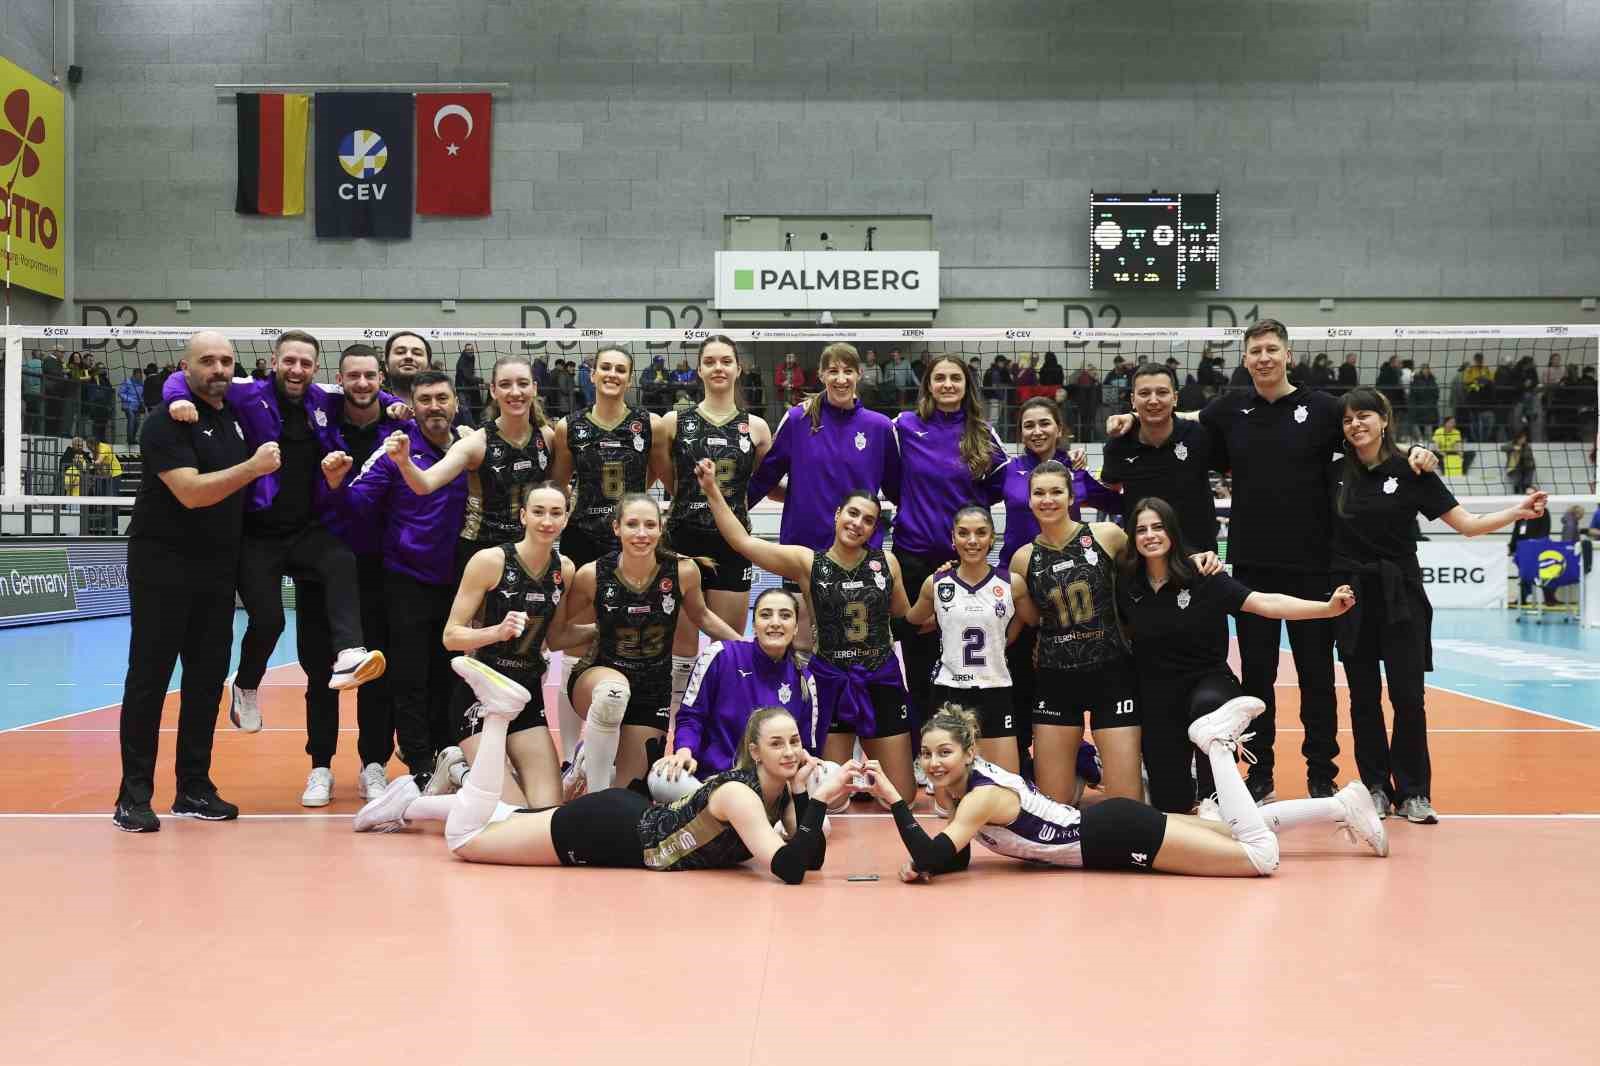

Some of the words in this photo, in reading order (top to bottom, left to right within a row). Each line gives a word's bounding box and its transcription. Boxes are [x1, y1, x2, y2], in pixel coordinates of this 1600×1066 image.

[338, 183, 388, 201] CEV
[760, 270, 920, 290] PALMBERG
[54, 328, 69, 336] CEV
[81, 305, 138, 350] D3
[521, 305, 577, 350] D3
[646, 305, 704, 350] D2
[1016, 330, 1031, 338] CEV
[1064, 304, 1122, 349] D2
[602, 461, 625, 499] 8
[10, 568, 68, 598] Germany
[1421, 567, 1485, 584] BERG
[1050, 580, 1094, 627] 10
[844, 601, 869, 642] 3
[962, 627, 987, 668] 2
[952, 673, 974, 682] ZEREN
[900, 704, 908, 719] 3
[1115, 699, 1134, 715] 10
[1004, 714, 1013, 728] 2
